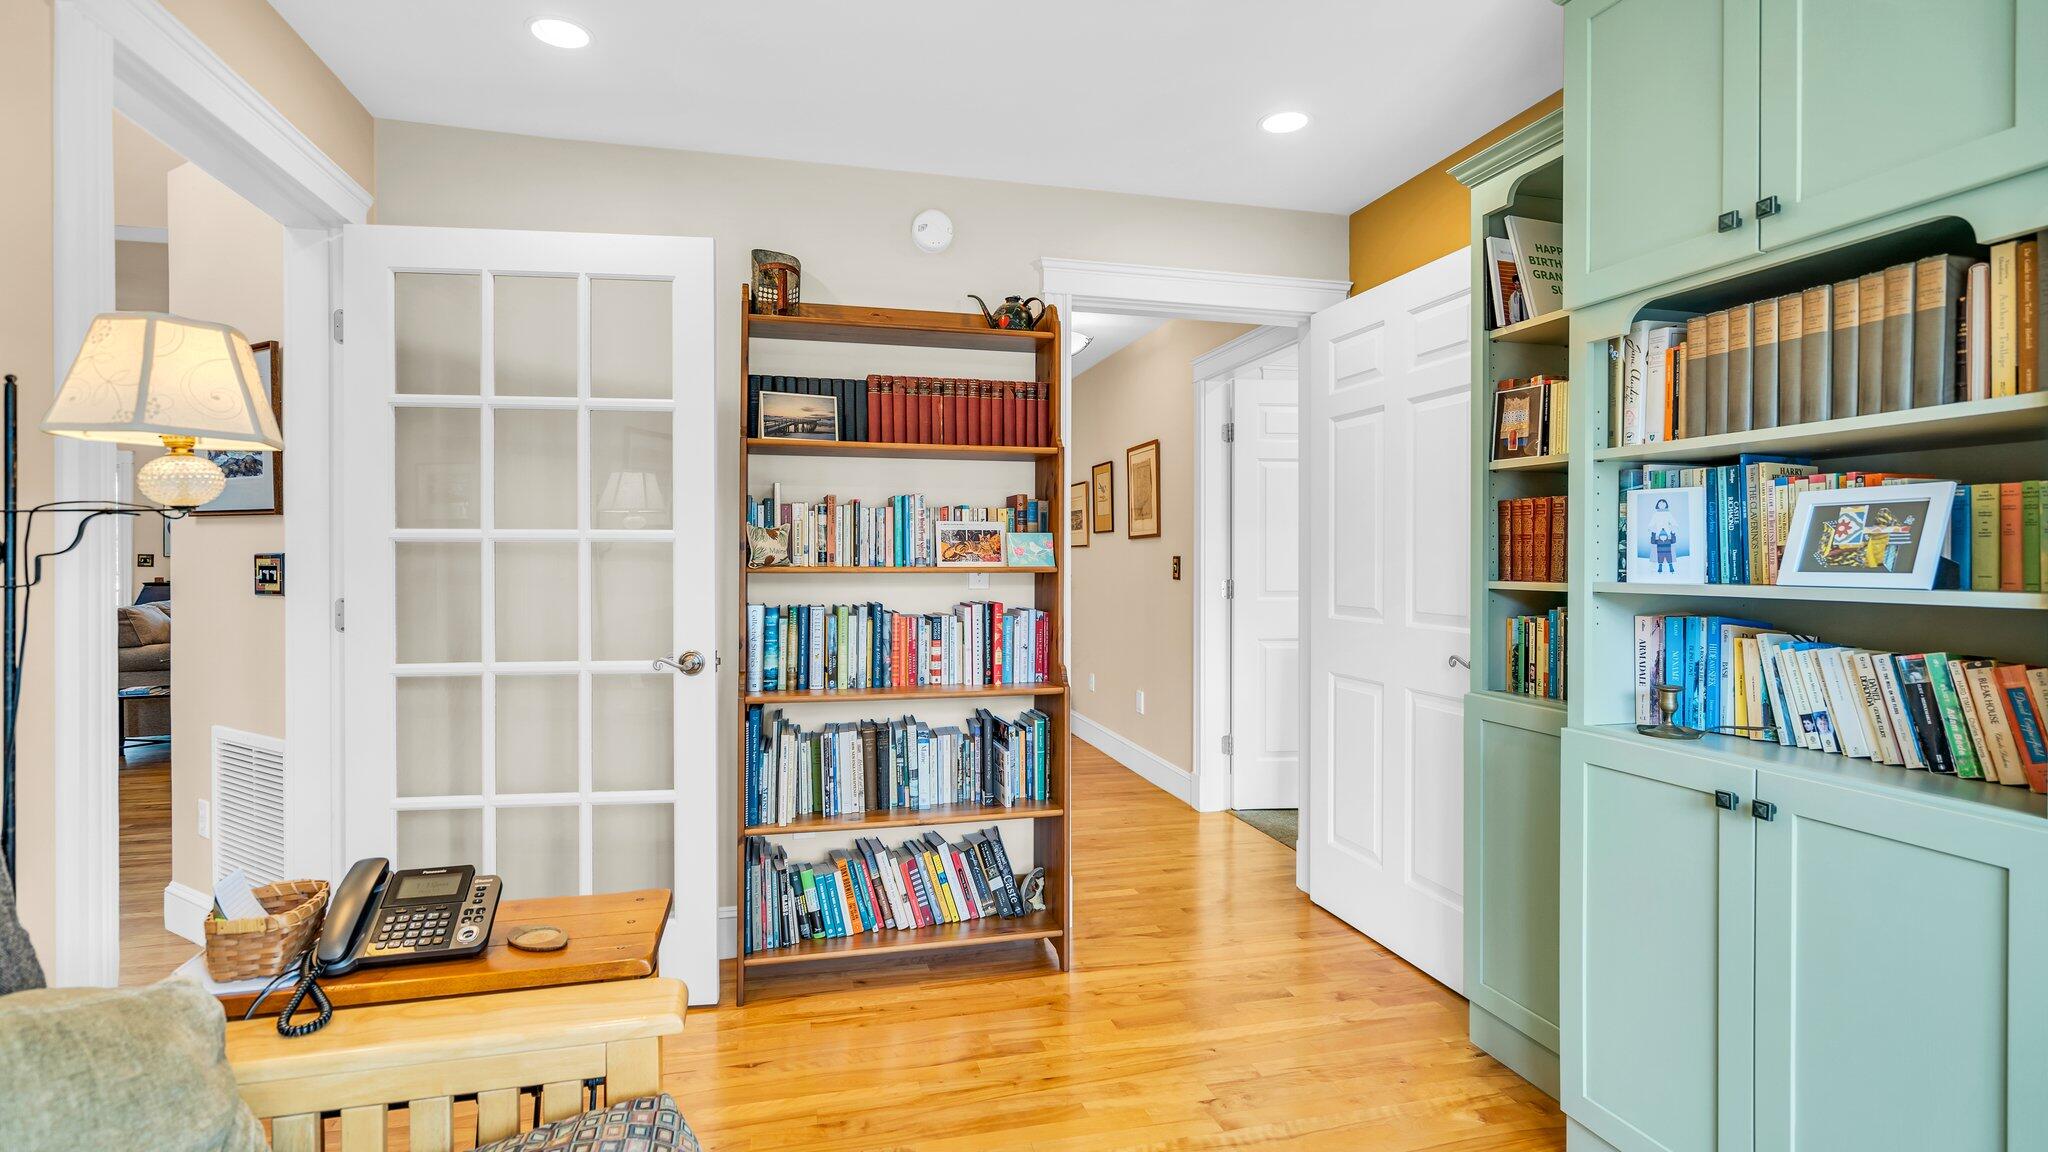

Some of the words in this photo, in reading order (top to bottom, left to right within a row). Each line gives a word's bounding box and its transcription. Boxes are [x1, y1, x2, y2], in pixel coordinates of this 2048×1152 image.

[1528, 255, 1563, 268] BIRTH
[1534, 243, 1563, 255] HAPP
[1532, 269, 1563, 281] GRAN
[1998, 294, 2008, 330] Anthony
[1625, 339, 1641, 366] Jane
[1998, 333, 2009, 368] Trollope
[1629, 368, 1641, 404] Austen
[1780, 467, 1803, 476] HARRY
[1748, 484, 1757, 501] THE
[1749, 501, 1759, 550] CLAVERINGS
[751, 608, 759, 642] Collected
[751, 643, 759, 668] Stories
[1637, 638, 1647, 687] ARMADALE
[1709, 643, 1718, 660] HIDE
[1671, 660, 1680, 681] NAME
[1708, 671, 1716, 687] SEEK
[1860, 675, 1875, 708] DERONDA
[1868, 678, 1881, 703] DANIEL
[1884, 681, 1892, 690] MILL
[1956, 680, 1967, 696] HARD
[1977, 677, 1992, 699] BLEAK
[1960, 697, 1972, 714] TIMES
[1984, 699, 2000, 725] HOUSE
[2012, 691, 2032, 716] David
[1871, 706, 1882, 724] GEORGE
[1878, 725, 1886, 738] ELIOT
[1946, 708, 1959, 731] Adam
[1952, 733, 1965, 756] Bede
[2019, 717, 2044, 757] Copperfield
[1003, 875, 1018, 904] Caste
